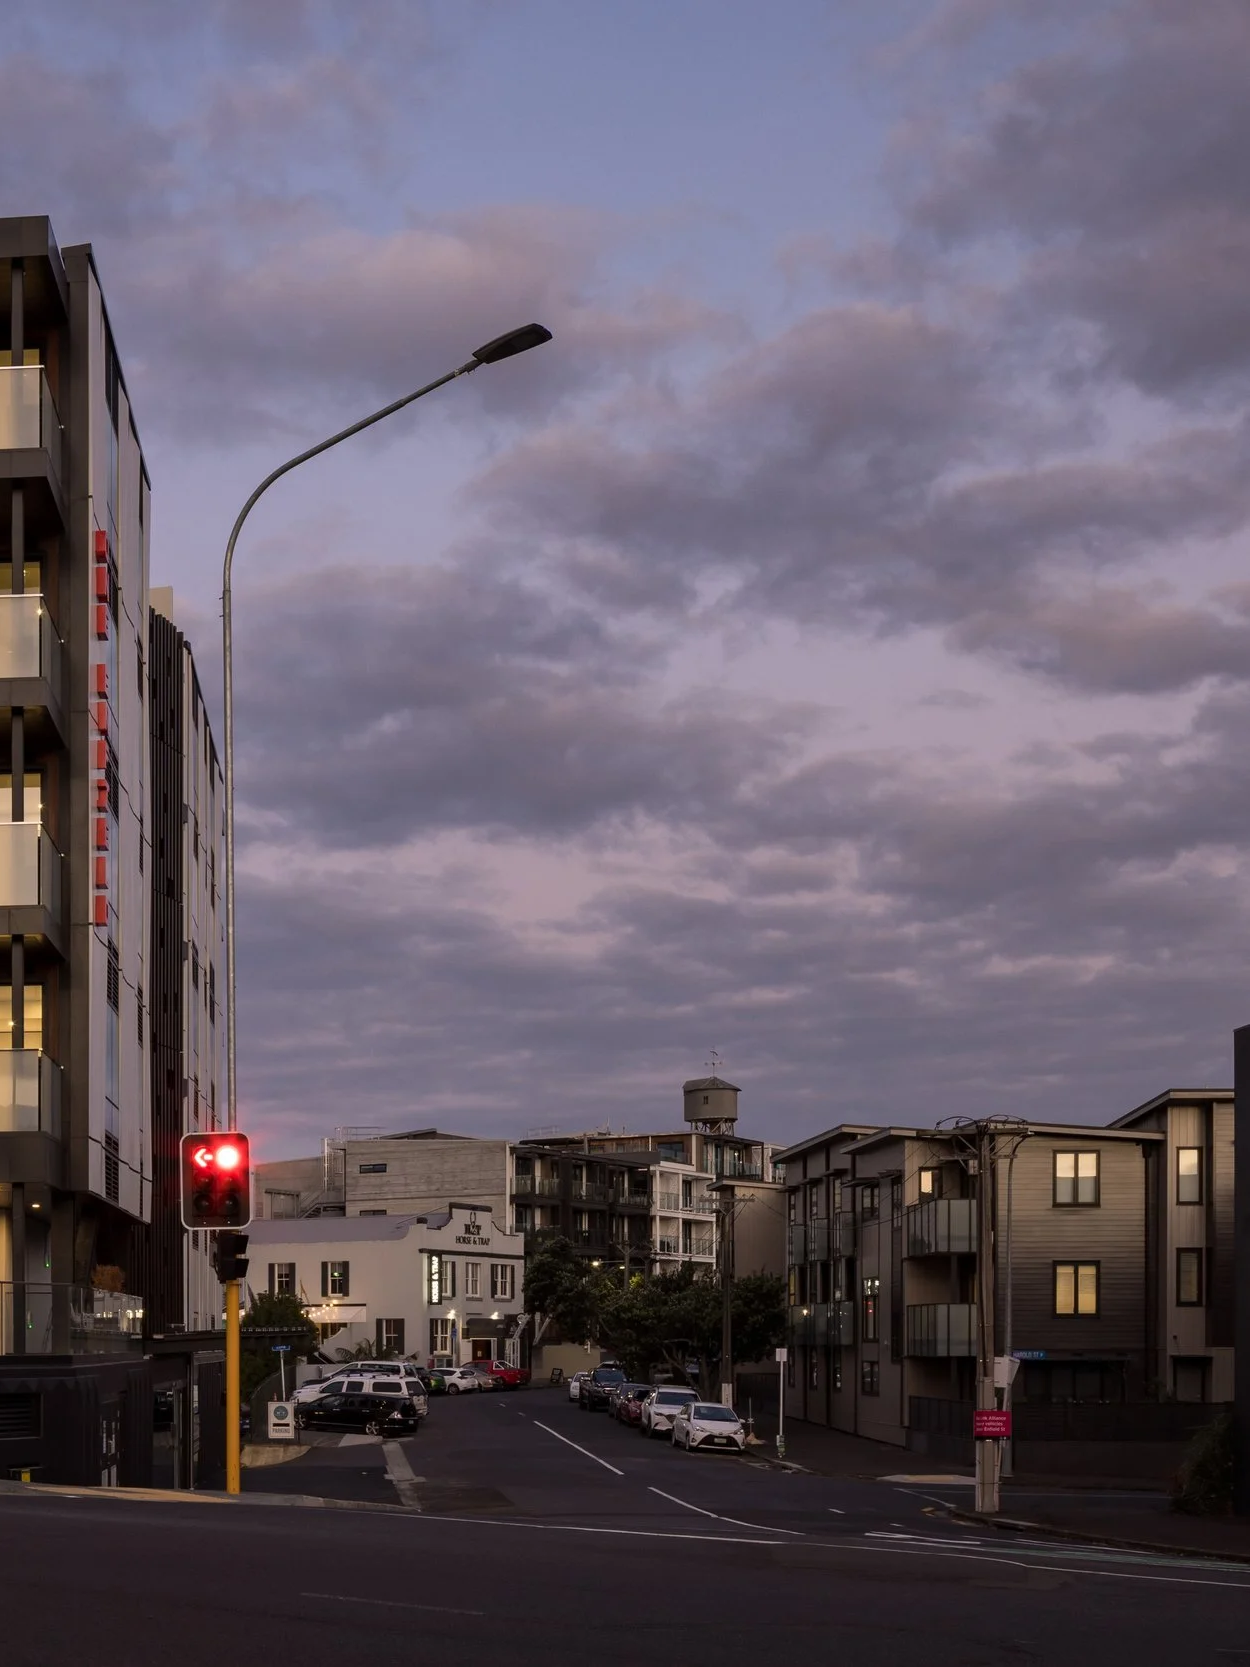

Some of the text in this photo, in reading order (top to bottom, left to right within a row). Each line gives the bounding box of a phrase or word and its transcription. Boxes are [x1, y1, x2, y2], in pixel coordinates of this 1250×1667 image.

[455, 1235, 491, 1246] HORSE & TRAP
